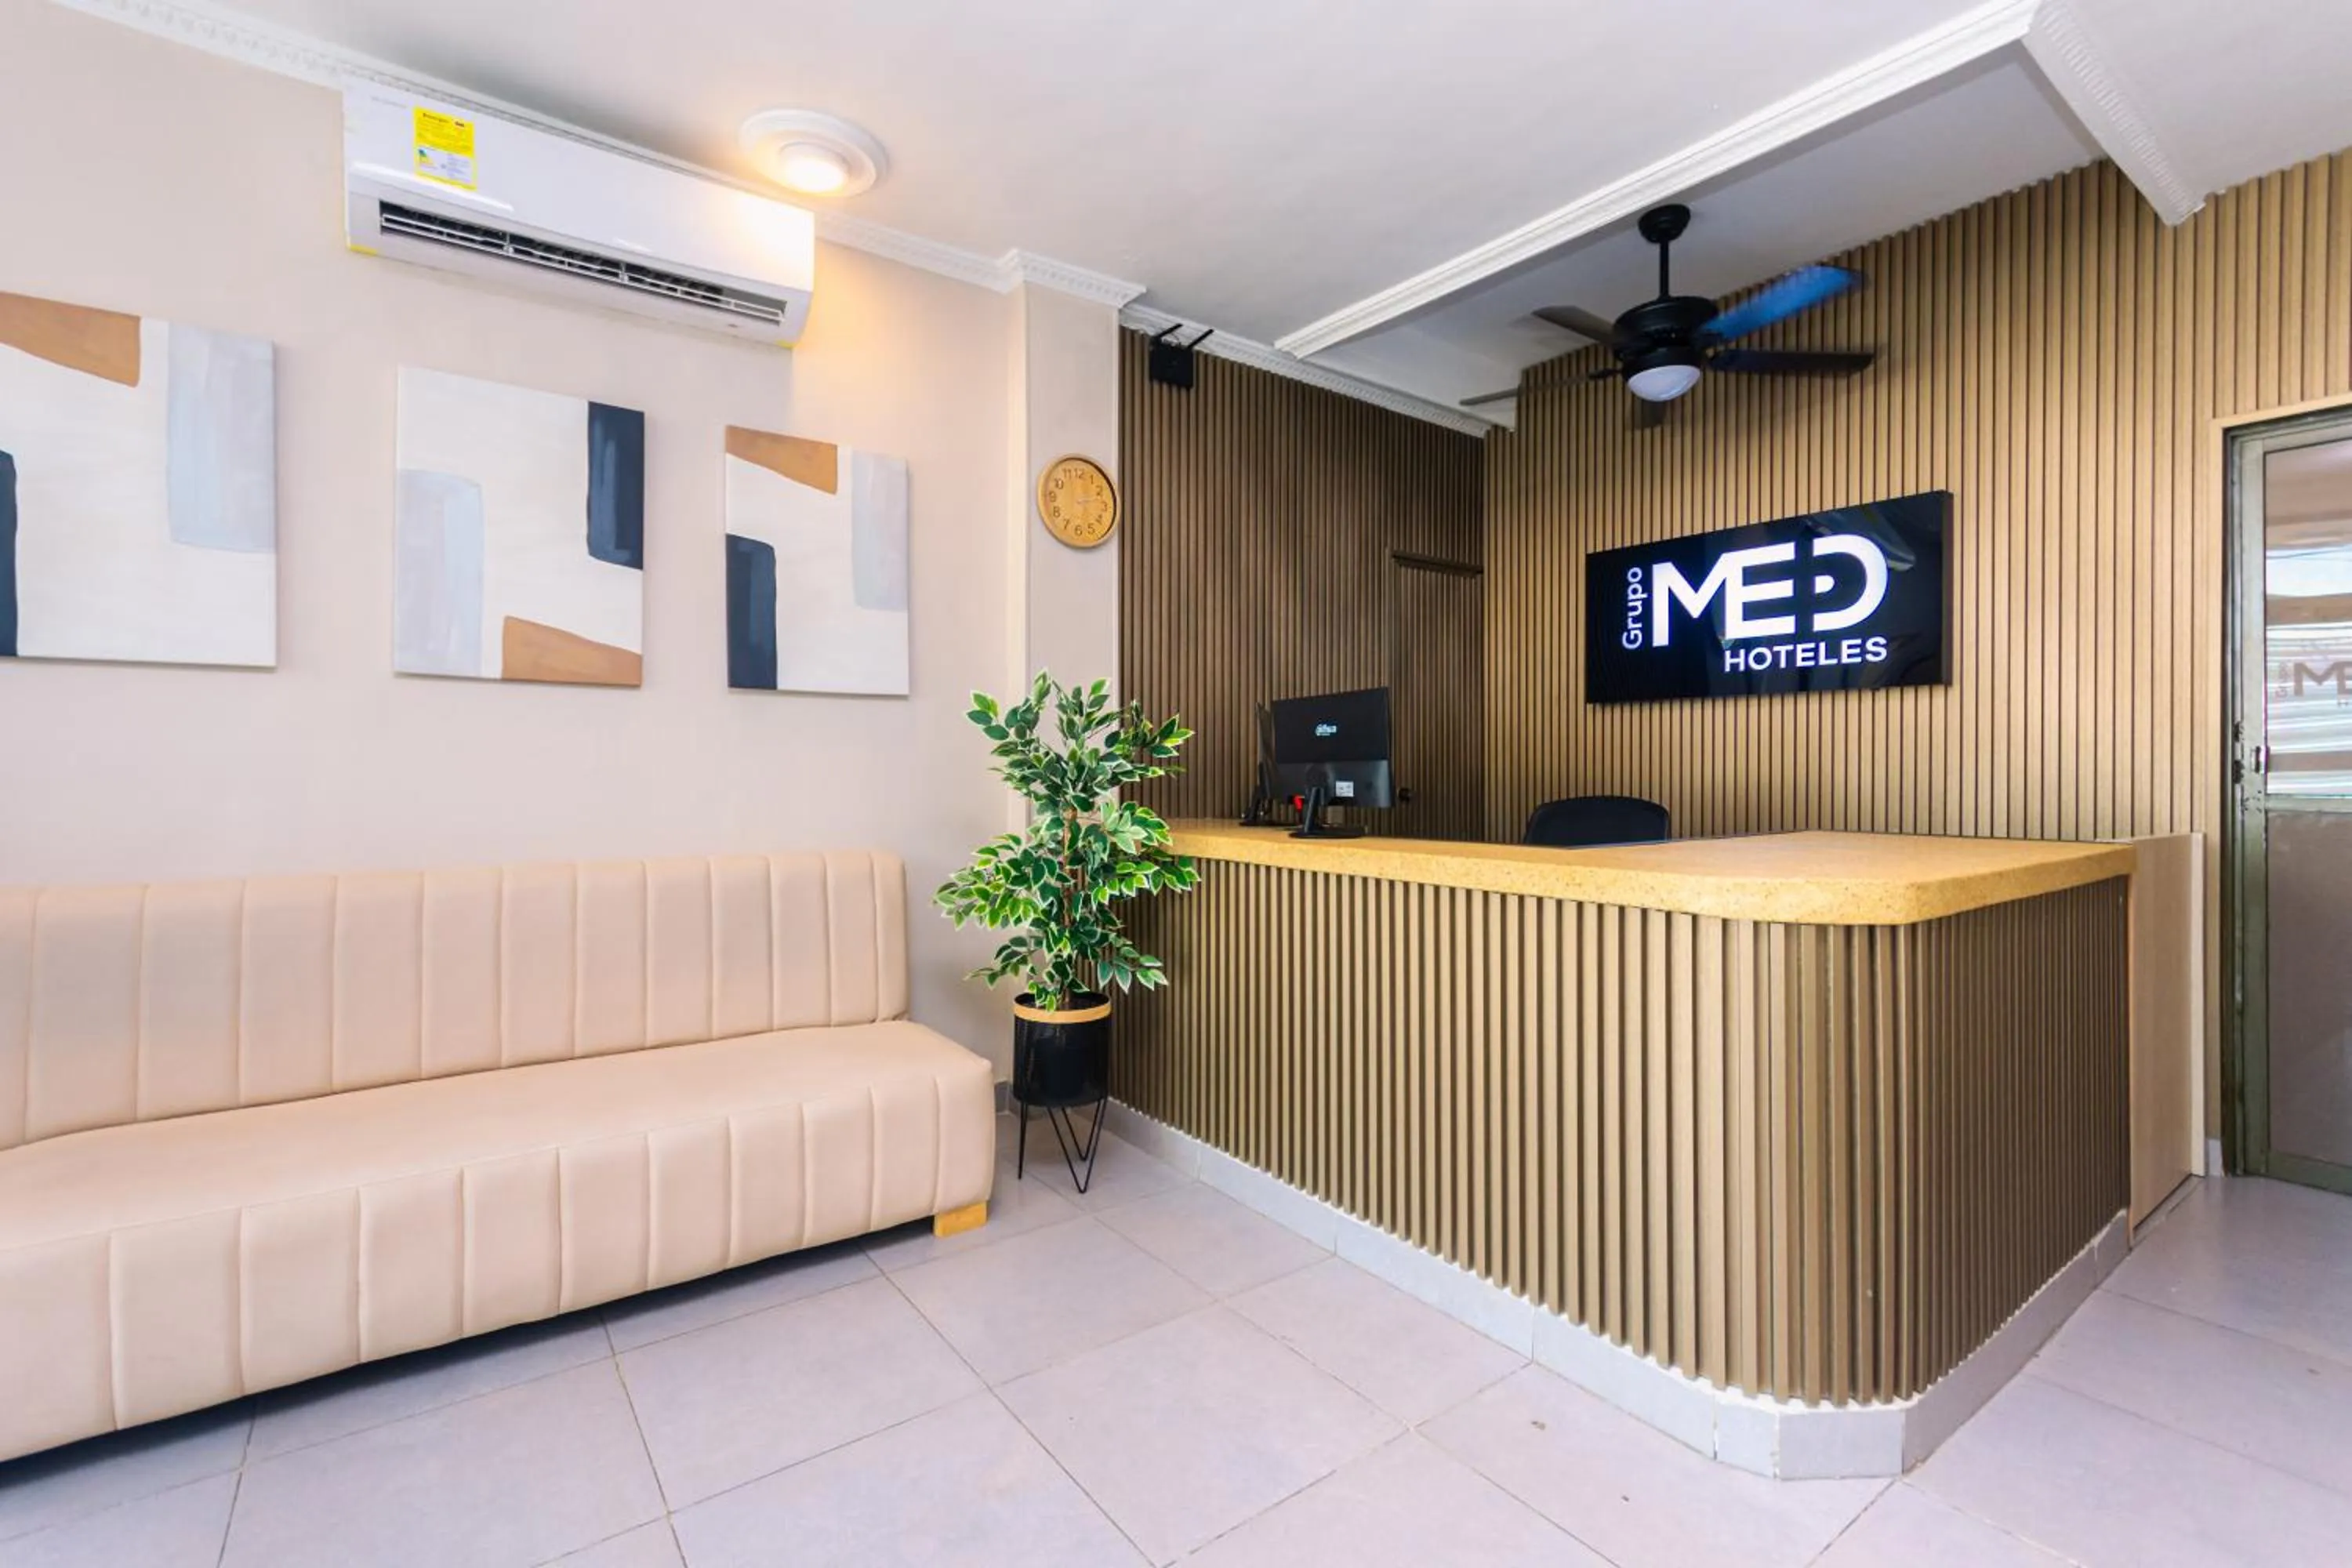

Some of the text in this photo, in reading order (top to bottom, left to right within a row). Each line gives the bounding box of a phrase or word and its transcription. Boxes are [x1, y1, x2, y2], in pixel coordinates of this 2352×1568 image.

[1063, 469, 1072, 480] 11
[1074, 468, 1085, 480] 12
[1090, 474, 1094, 485] 1
[1096, 485, 1103, 495] 2
[1049, 491, 1057, 503] 9
[1053, 506, 1061, 517] 8
[1102, 500, 1108, 512] 3
[1064, 518, 1070, 530] 7
[1074, 524, 1082, 536] 6
[1087, 523, 1095, 535] 5
[1652, 534, 1889, 648] MED
[1622, 567, 1648, 650] Grupo
[1724, 636, 1888, 673] HOTELES
